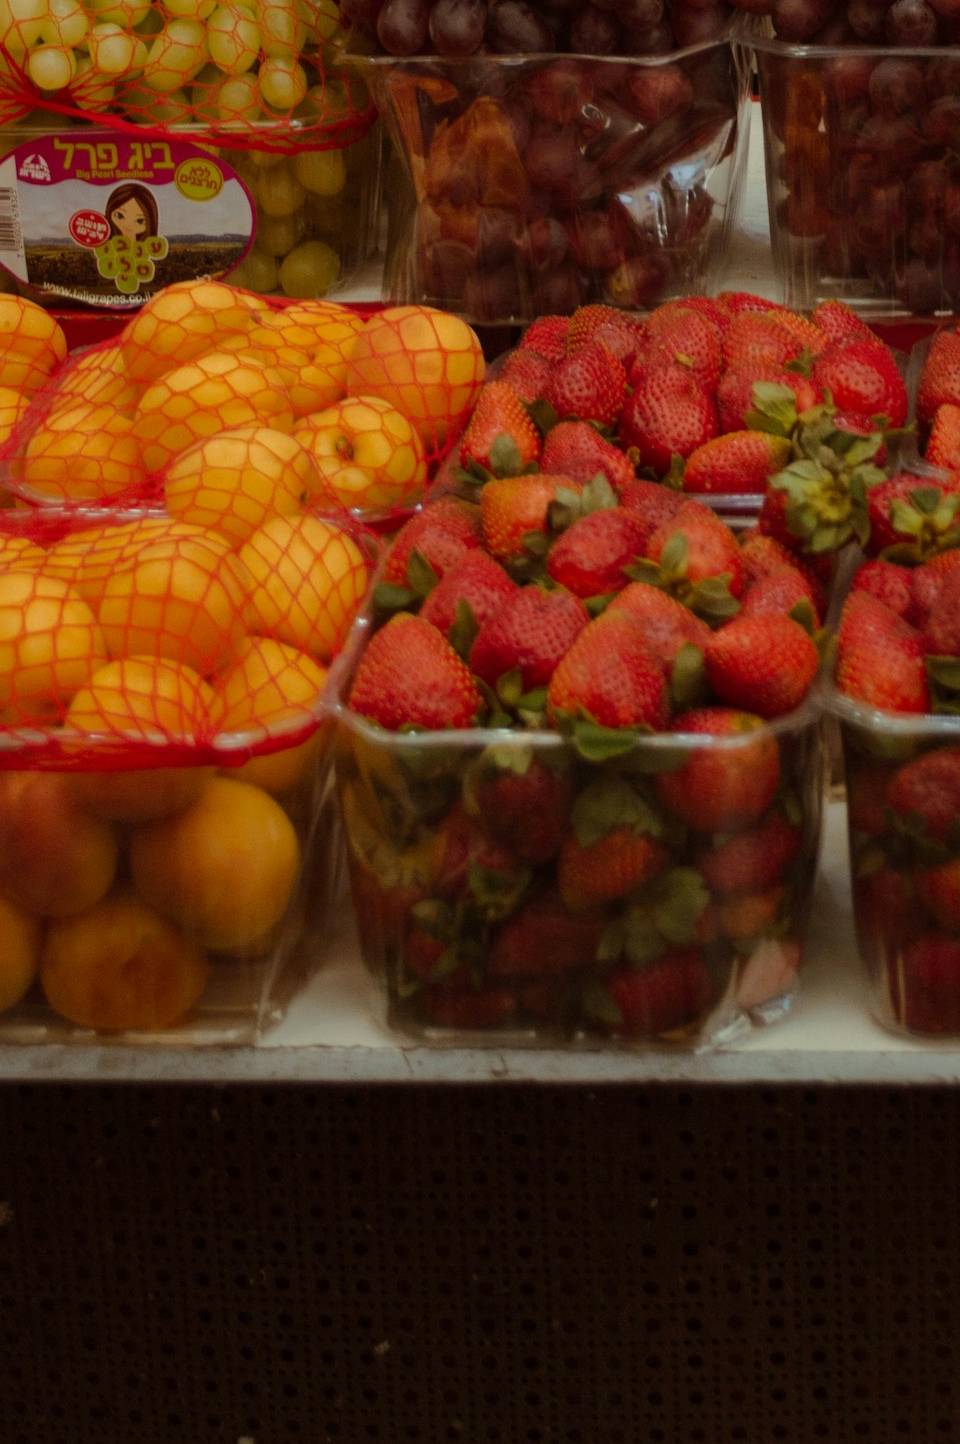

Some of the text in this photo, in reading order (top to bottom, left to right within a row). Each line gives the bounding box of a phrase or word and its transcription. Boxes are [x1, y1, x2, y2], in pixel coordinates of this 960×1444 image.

[53, 137, 176, 170] ביג פרל
[75, 169, 154, 180] Big Pearl Seedless
